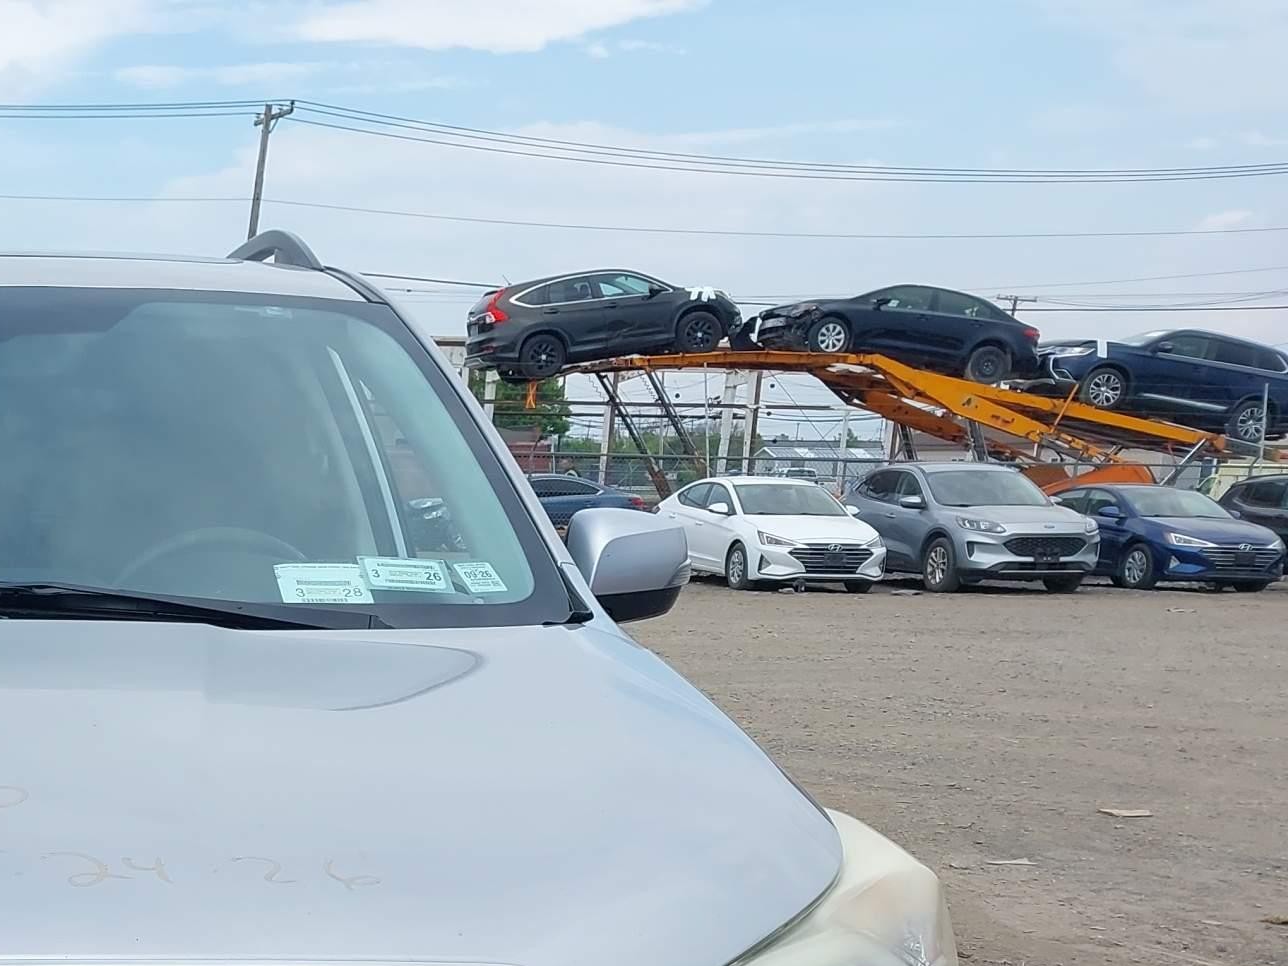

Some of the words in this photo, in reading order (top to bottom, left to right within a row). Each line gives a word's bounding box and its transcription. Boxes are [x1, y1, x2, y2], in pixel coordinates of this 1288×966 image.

[372, 569, 380, 578] 3
[424, 571, 442, 581] 26
[295, 587, 305, 597] 3
[342, 587, 363, 597] 28
